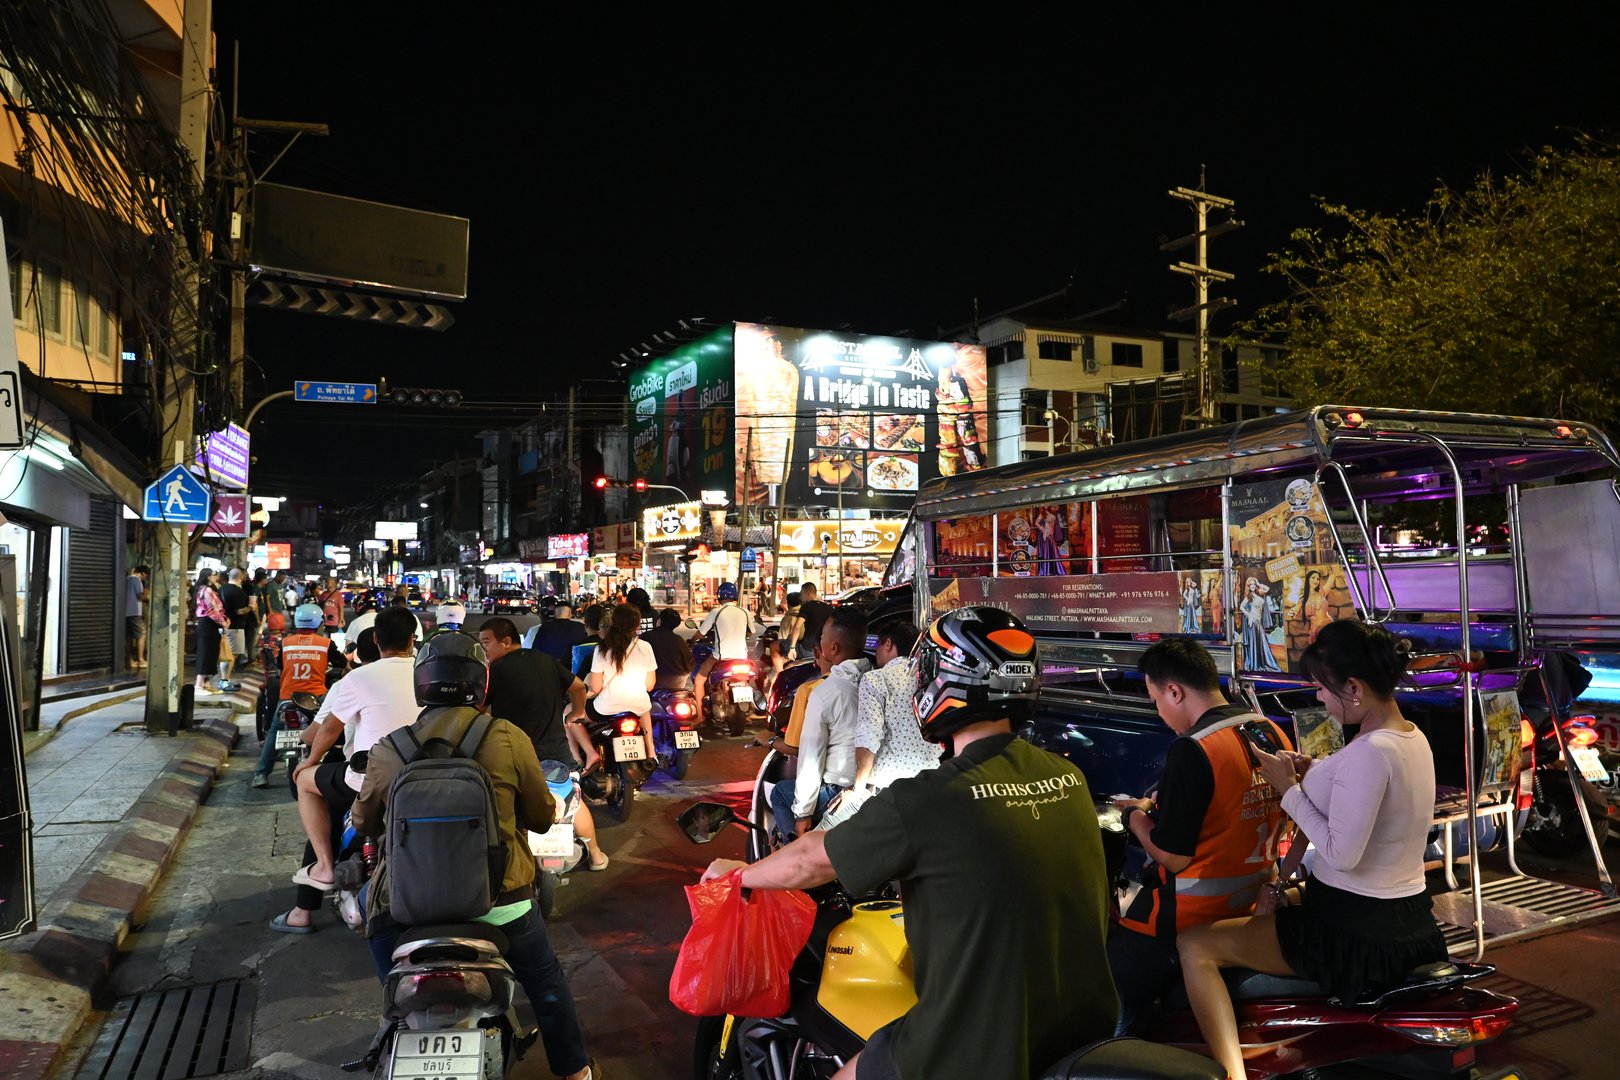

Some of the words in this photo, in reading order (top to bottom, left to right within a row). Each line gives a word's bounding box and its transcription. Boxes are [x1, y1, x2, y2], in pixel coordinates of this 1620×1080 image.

[325, 384, 355, 395] พัทยาใต้
[629, 375, 664, 401] GrabBike
[669, 370, 692, 391] ราคาใหม่
[803, 375, 815, 401] A
[818, 376, 869, 409] Bridge
[872, 381, 889, 407] To
[892, 383, 930, 409] Taste
[702, 405, 726, 451] 19
[292, 663, 311, 680] 12
[1006, 665, 1031, 674] INDEX
[624, 751, 638, 759] 140
[970, 773, 1082, 800] HIGHSCHOOL
[1006, 780, 1069, 820] original
[418, 1036, 462, 1054] งคจ
[422, 1058, 453, 1074] ชลบุรี
